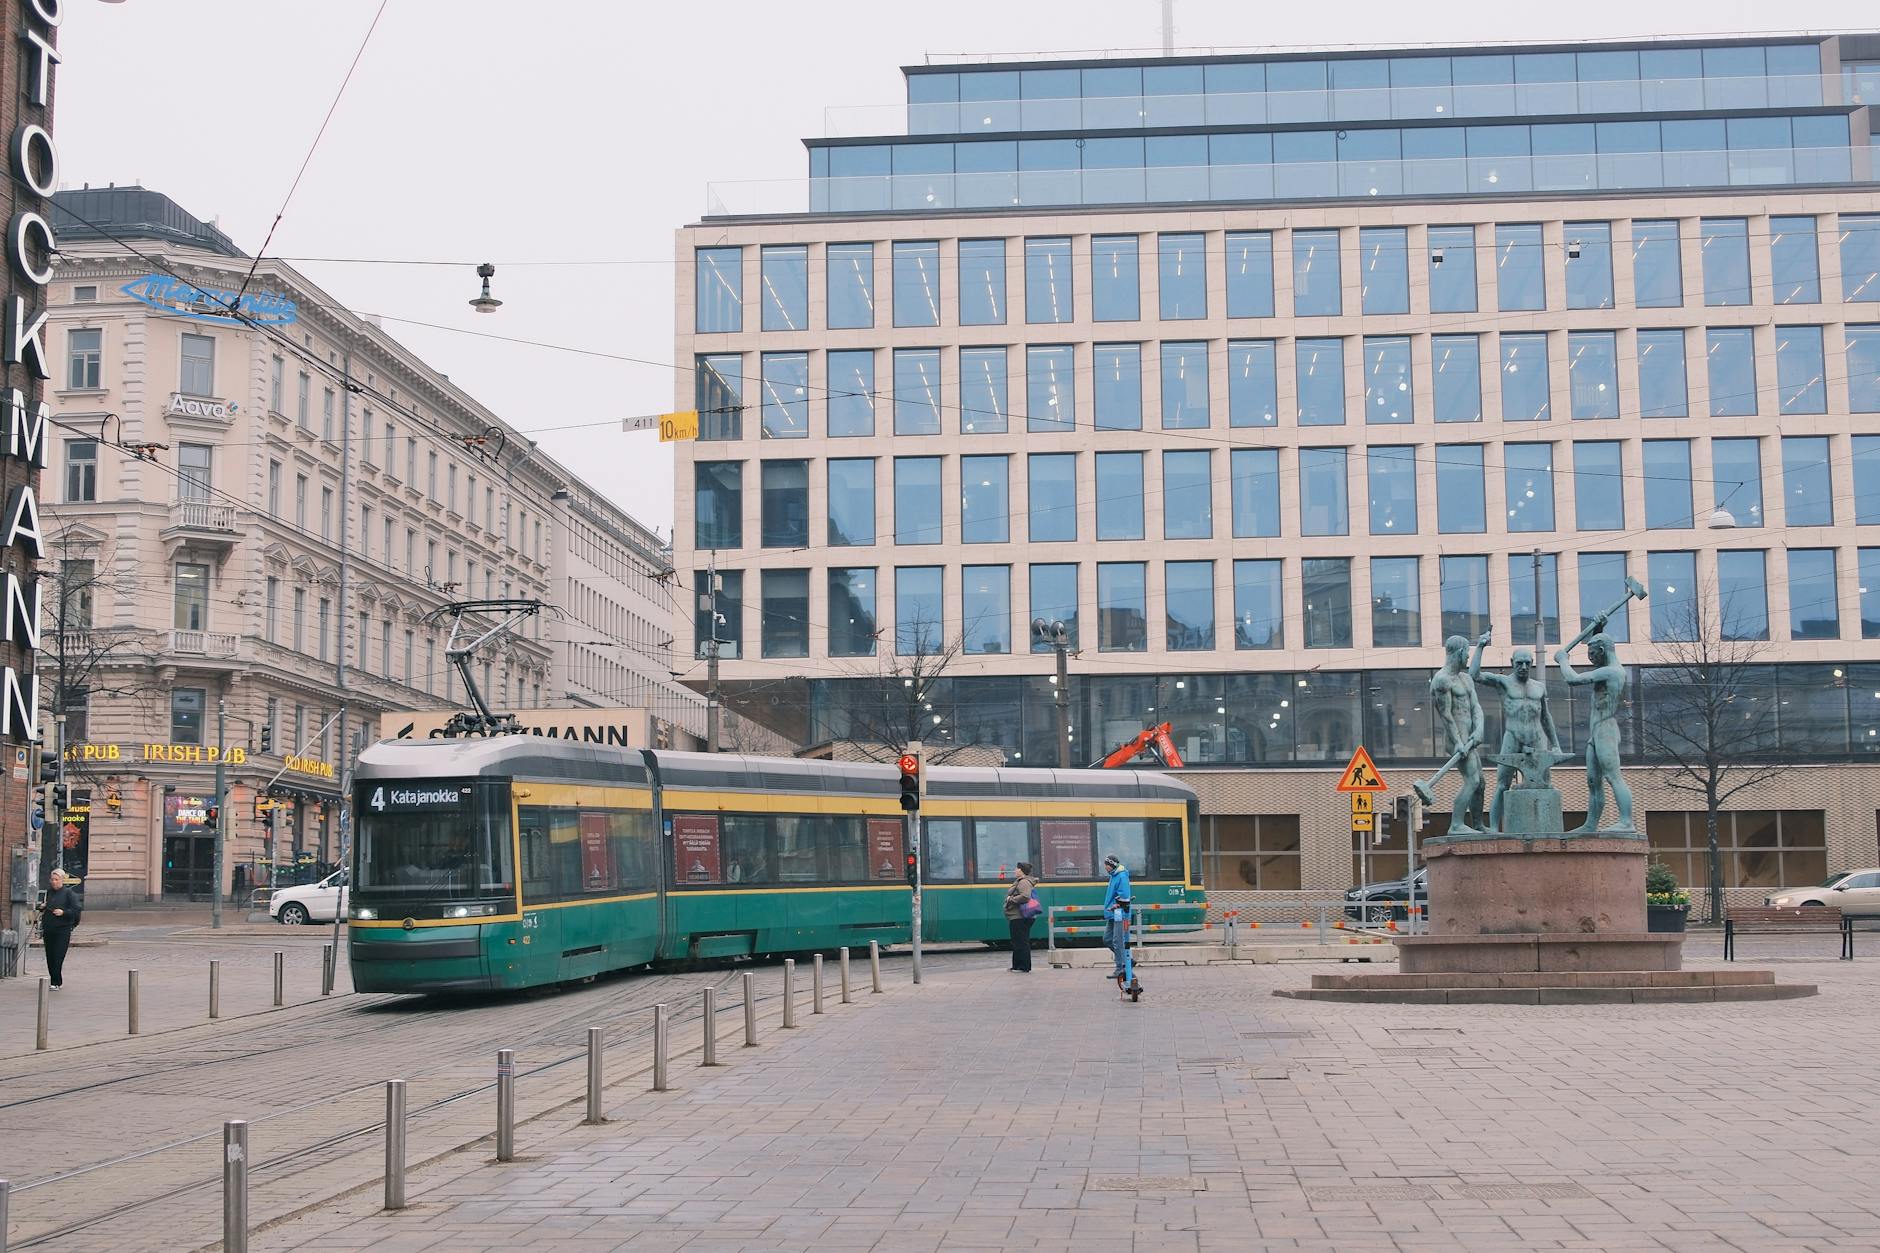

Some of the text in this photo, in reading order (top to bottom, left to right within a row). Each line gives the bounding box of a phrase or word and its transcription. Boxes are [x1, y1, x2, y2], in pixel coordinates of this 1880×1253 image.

[170, 394, 227, 417] Aava
[84, 744, 119, 760] PUB
[144, 744, 200, 761] IRISH
[370, 786, 459, 811] 4 Katajanokka
